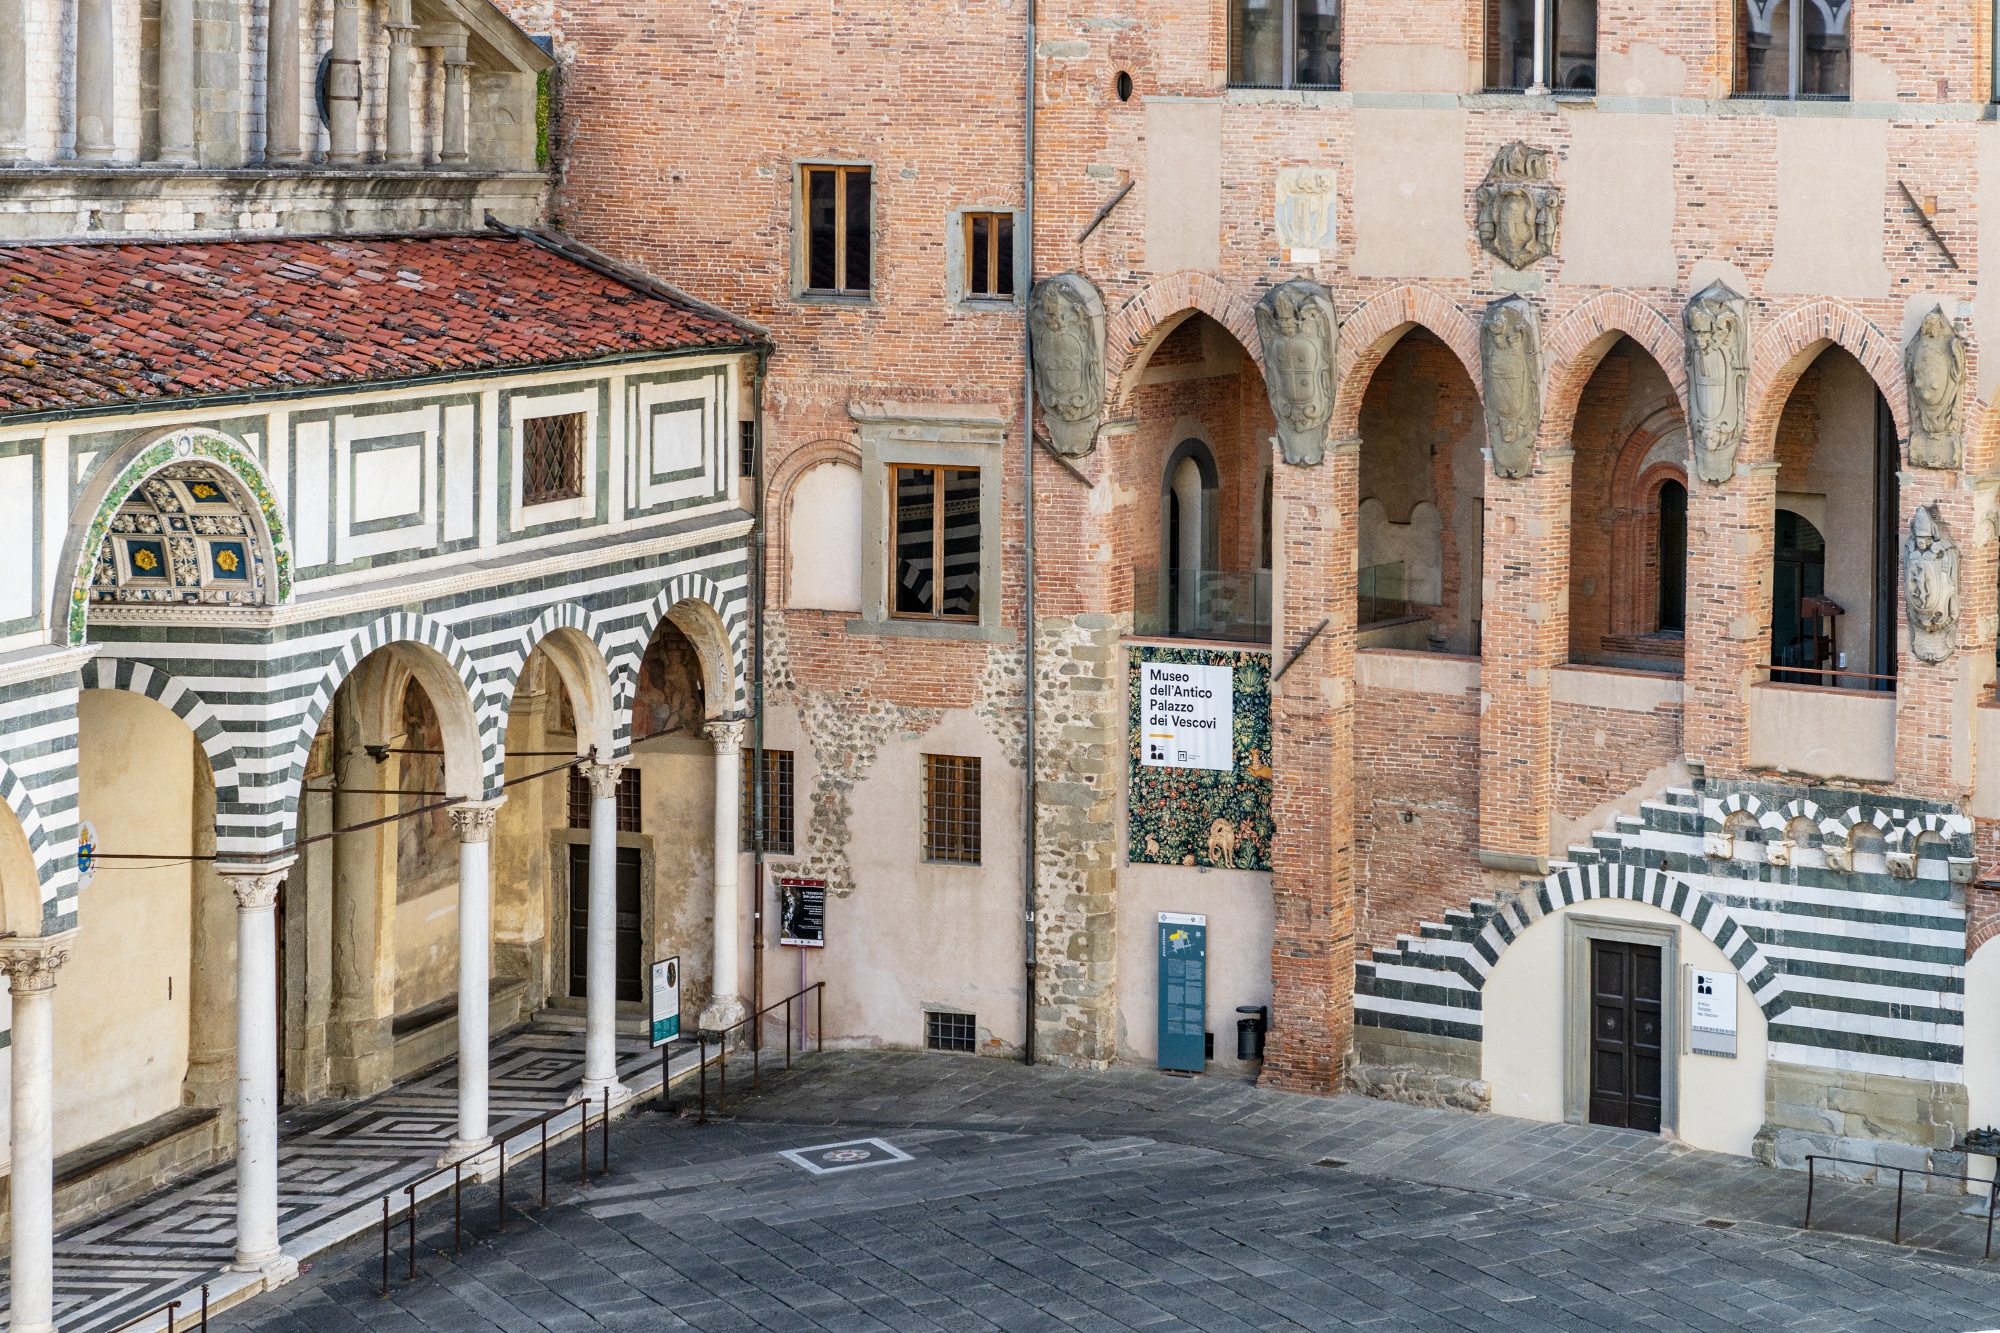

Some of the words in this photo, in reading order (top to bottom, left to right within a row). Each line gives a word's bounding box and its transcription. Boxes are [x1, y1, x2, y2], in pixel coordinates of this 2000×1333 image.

[1150, 669, 1189, 682] Museo
[1150, 684, 1212, 698] dell'Antico
[1150, 699, 1194, 712] Palazzo
[1150, 714, 1167, 726] dei
[1171, 715, 1216, 729] Vescovi
